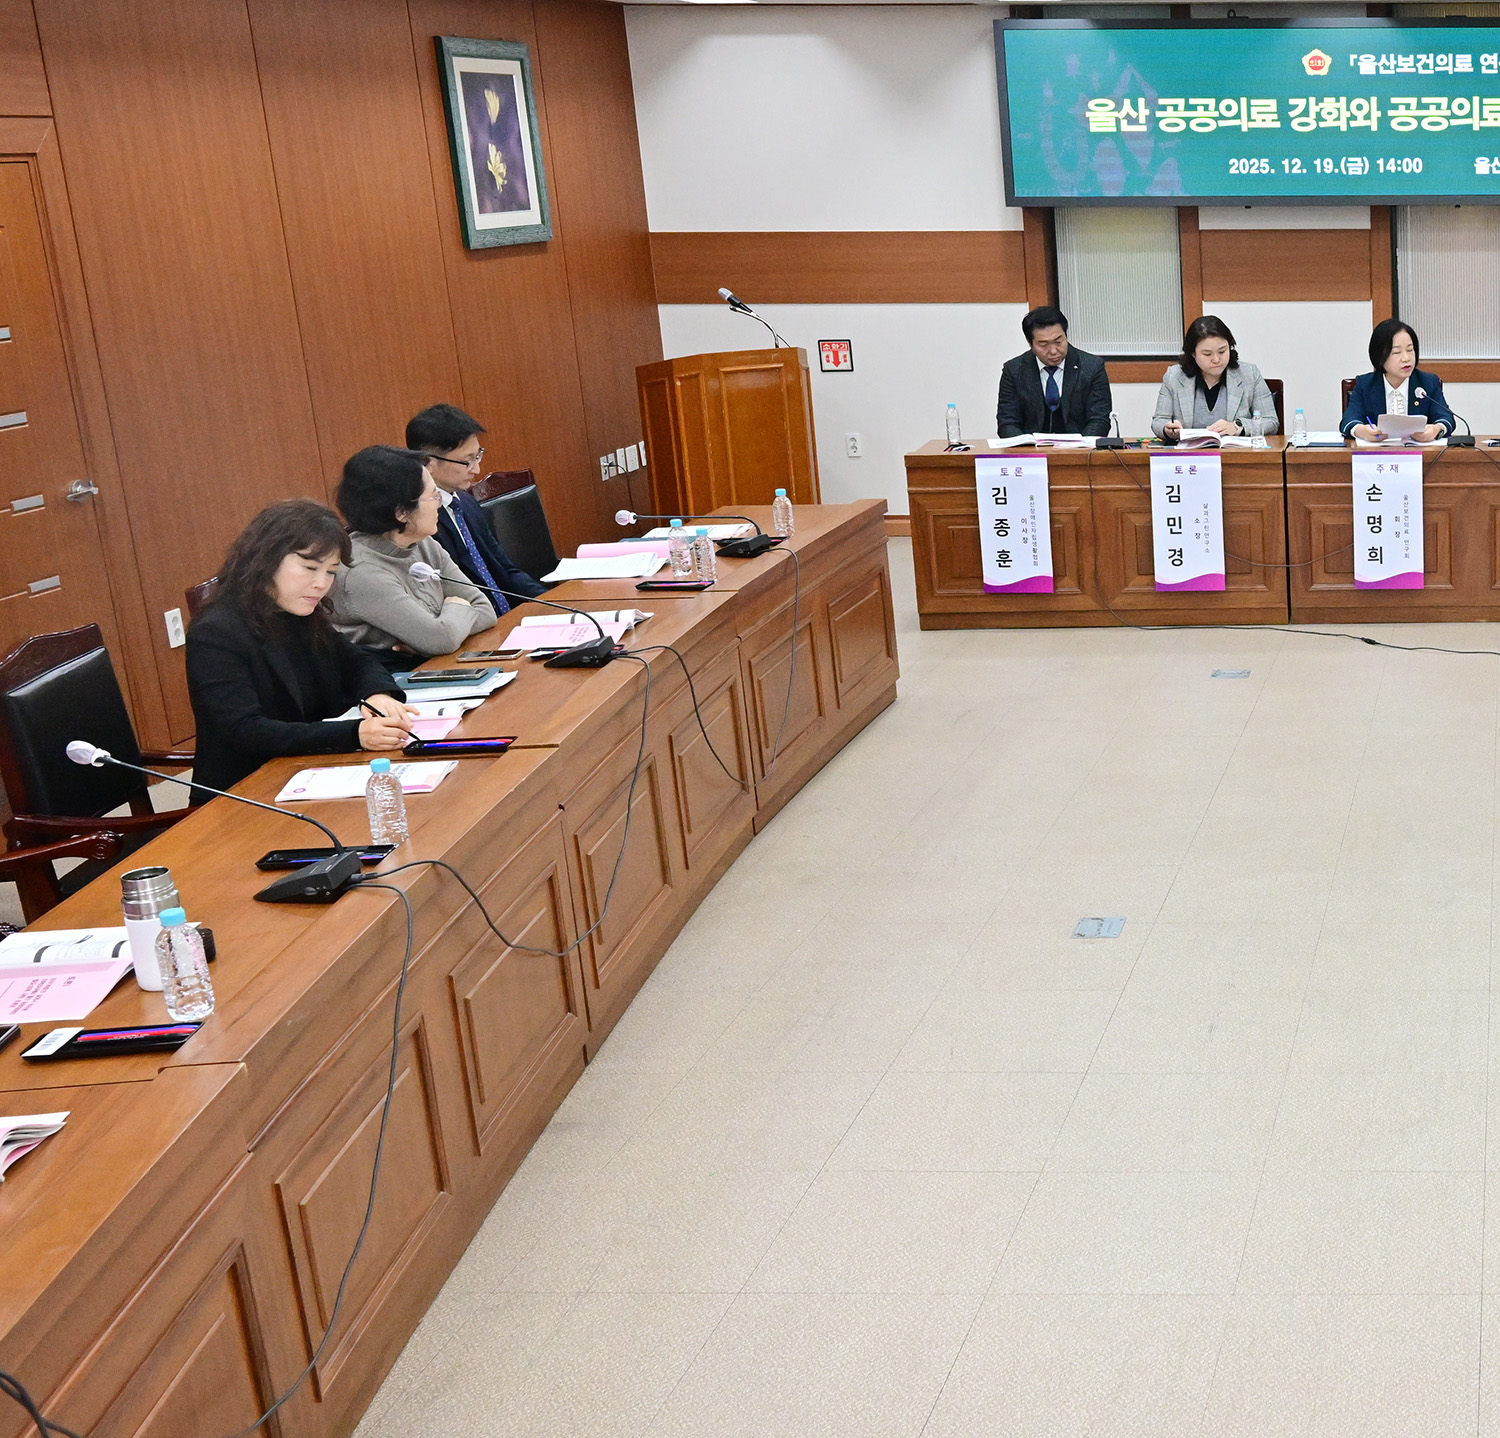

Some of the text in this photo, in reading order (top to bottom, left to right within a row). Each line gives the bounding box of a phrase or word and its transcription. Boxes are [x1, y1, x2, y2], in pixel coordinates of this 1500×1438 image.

[1085, 97, 1150, 132] 울산
[1155, 97, 1281, 132] 공공의료
[1287, 96, 1382, 132] 강화와
[1228, 156, 1423, 176] 2025. 12. 19.(금) 14:00
[1000, 466, 1023, 476] 토론
[1174, 465, 1198, 475] 토론
[1376, 464, 1399, 474] 주재
[992, 486, 1012, 568] 김종훈
[1020, 518, 1028, 544] 이사장
[1166, 484, 1184, 567] 김민경
[1194, 518, 1201, 540] 소장
[1366, 484, 1383, 564] 손명희
[1394, 516, 1400, 538] 회장
